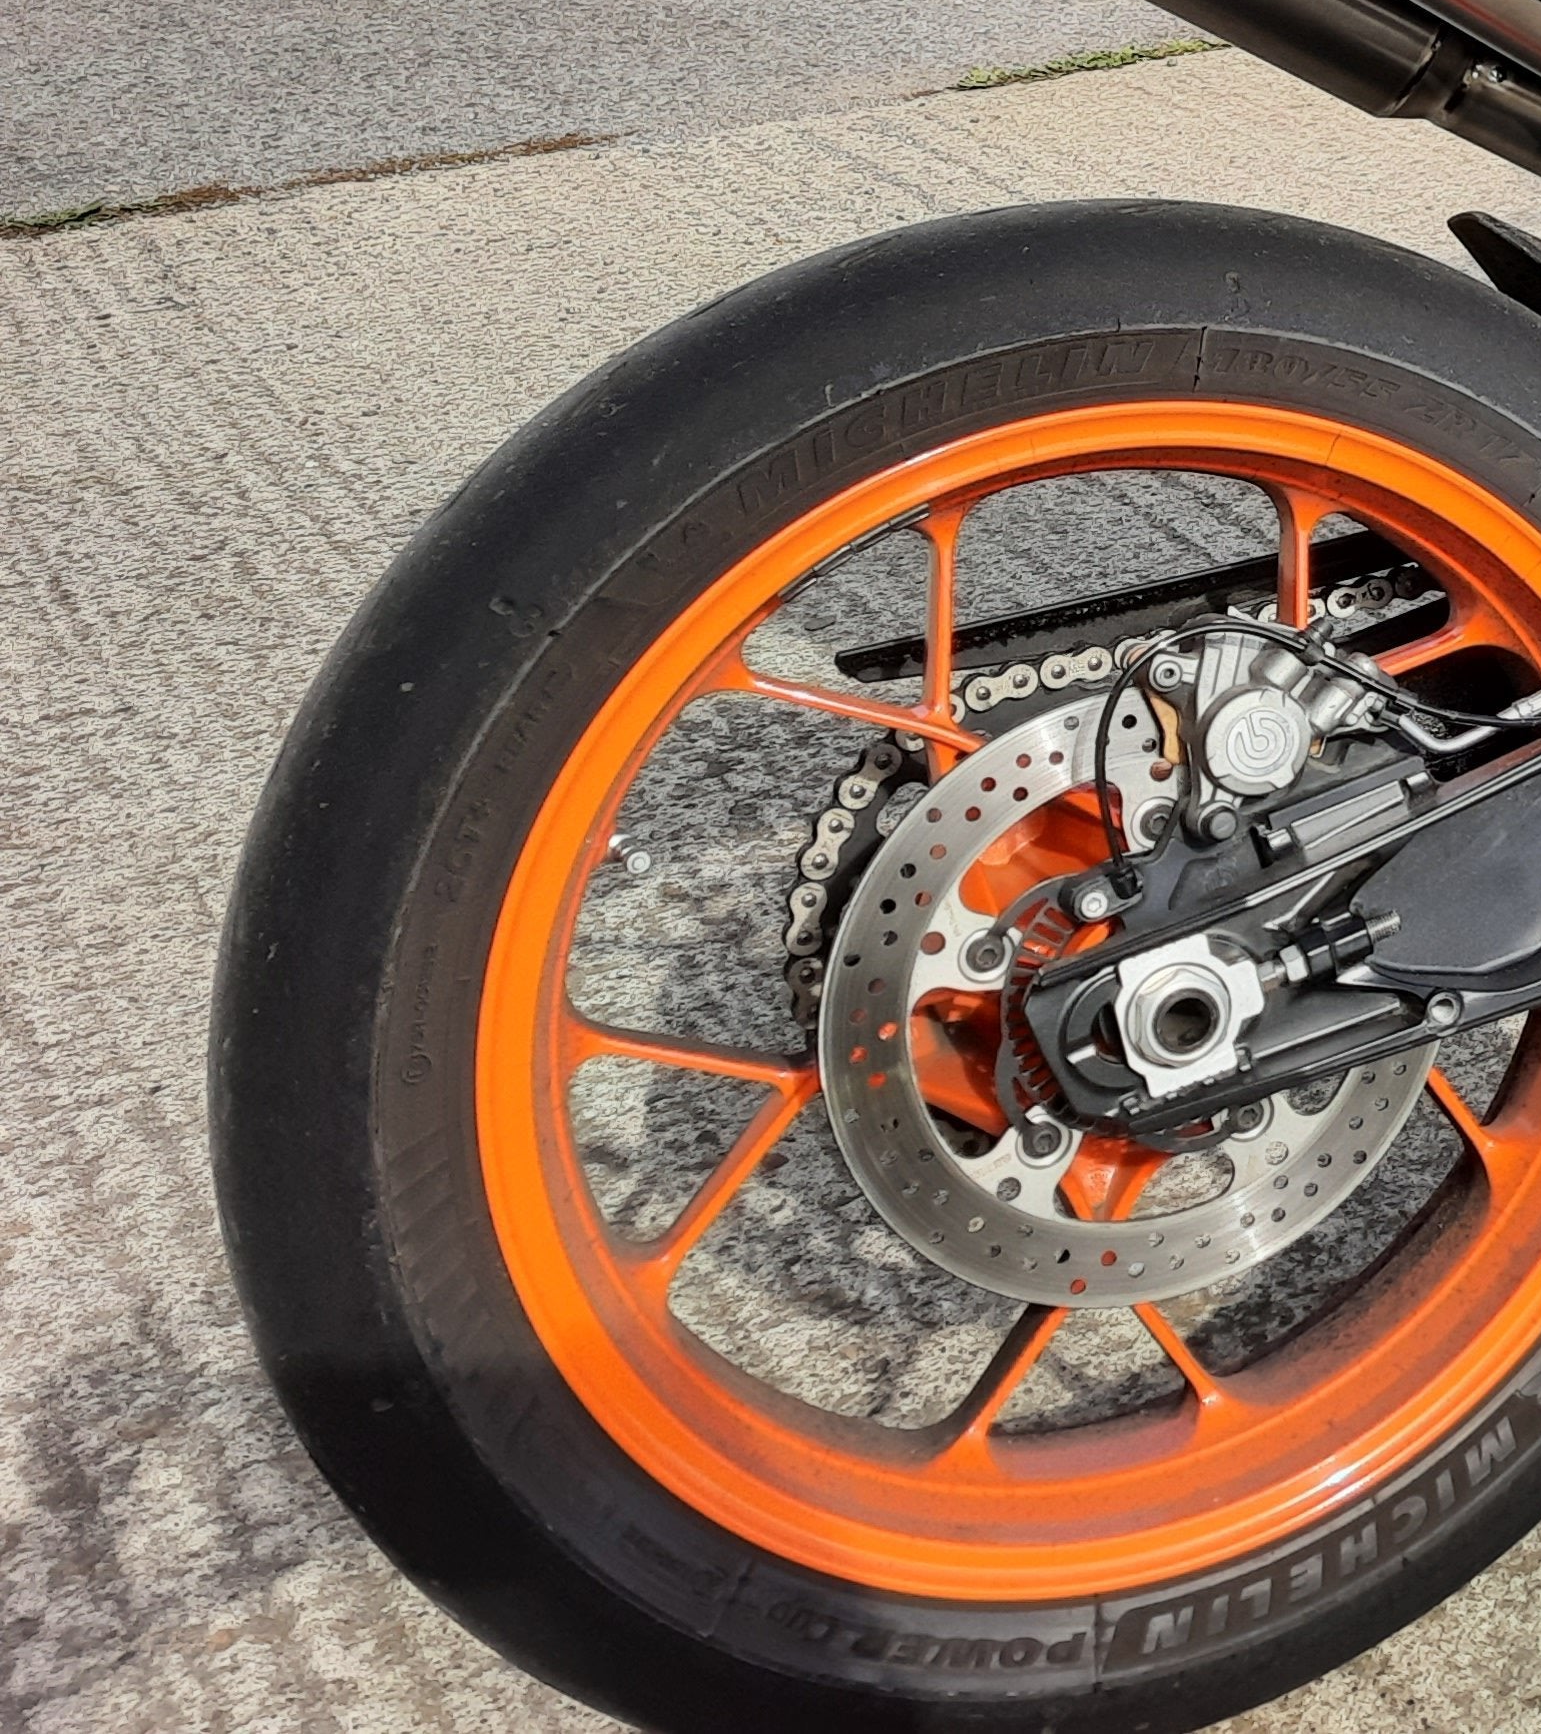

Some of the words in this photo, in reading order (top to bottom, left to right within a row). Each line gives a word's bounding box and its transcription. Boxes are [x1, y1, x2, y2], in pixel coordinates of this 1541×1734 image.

[737, 337, 1158, 517] MICHELIN
[1141, 1415, 1517, 1656] MICHELIN
[848, 1630, 1088, 1668] POWER
